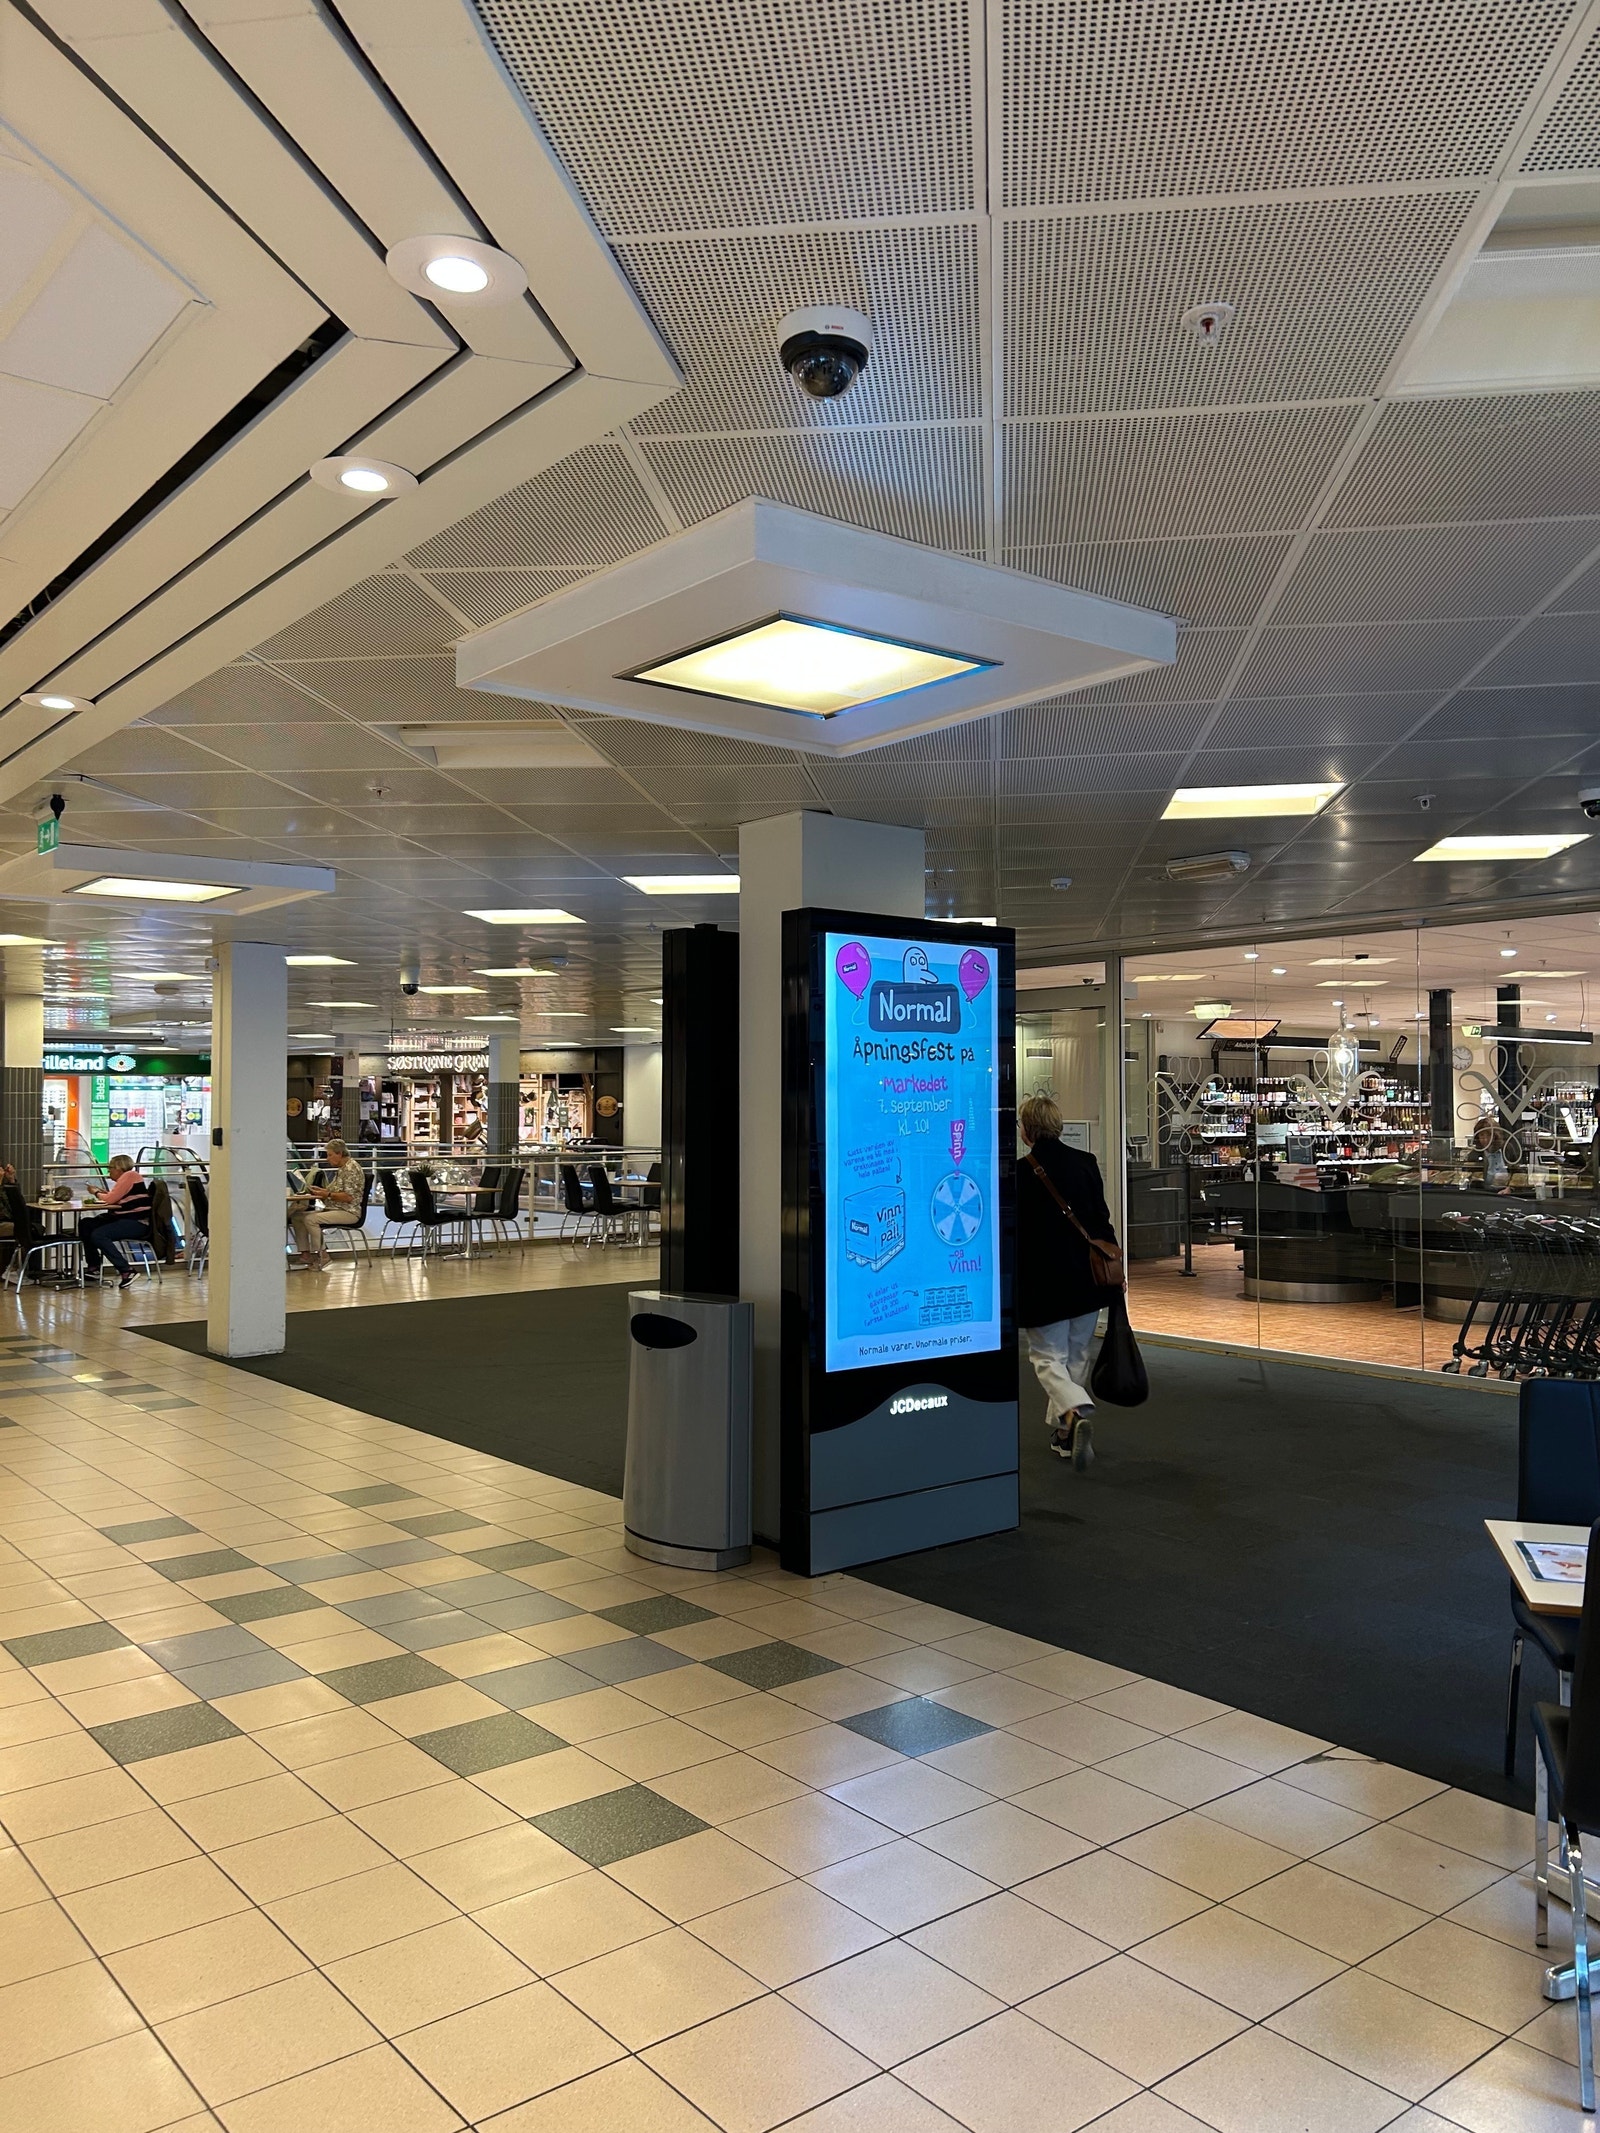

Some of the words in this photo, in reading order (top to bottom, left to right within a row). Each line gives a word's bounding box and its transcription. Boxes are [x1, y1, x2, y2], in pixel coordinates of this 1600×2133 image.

[879, 988, 951, 1023] Normal
[853, 1035, 955, 1064] Åpningsfest
[960, 1047, 975, 1065] på
[876, 1204, 902, 1223] Vinn
[859, 1343, 889, 1357] Normale
[890, 1341, 915, 1353] varer.
[915, 1336, 949, 1349] Unormale
[949, 1334, 973, 1347] priser.
[889, 1395, 949, 1415] JCDecaux
